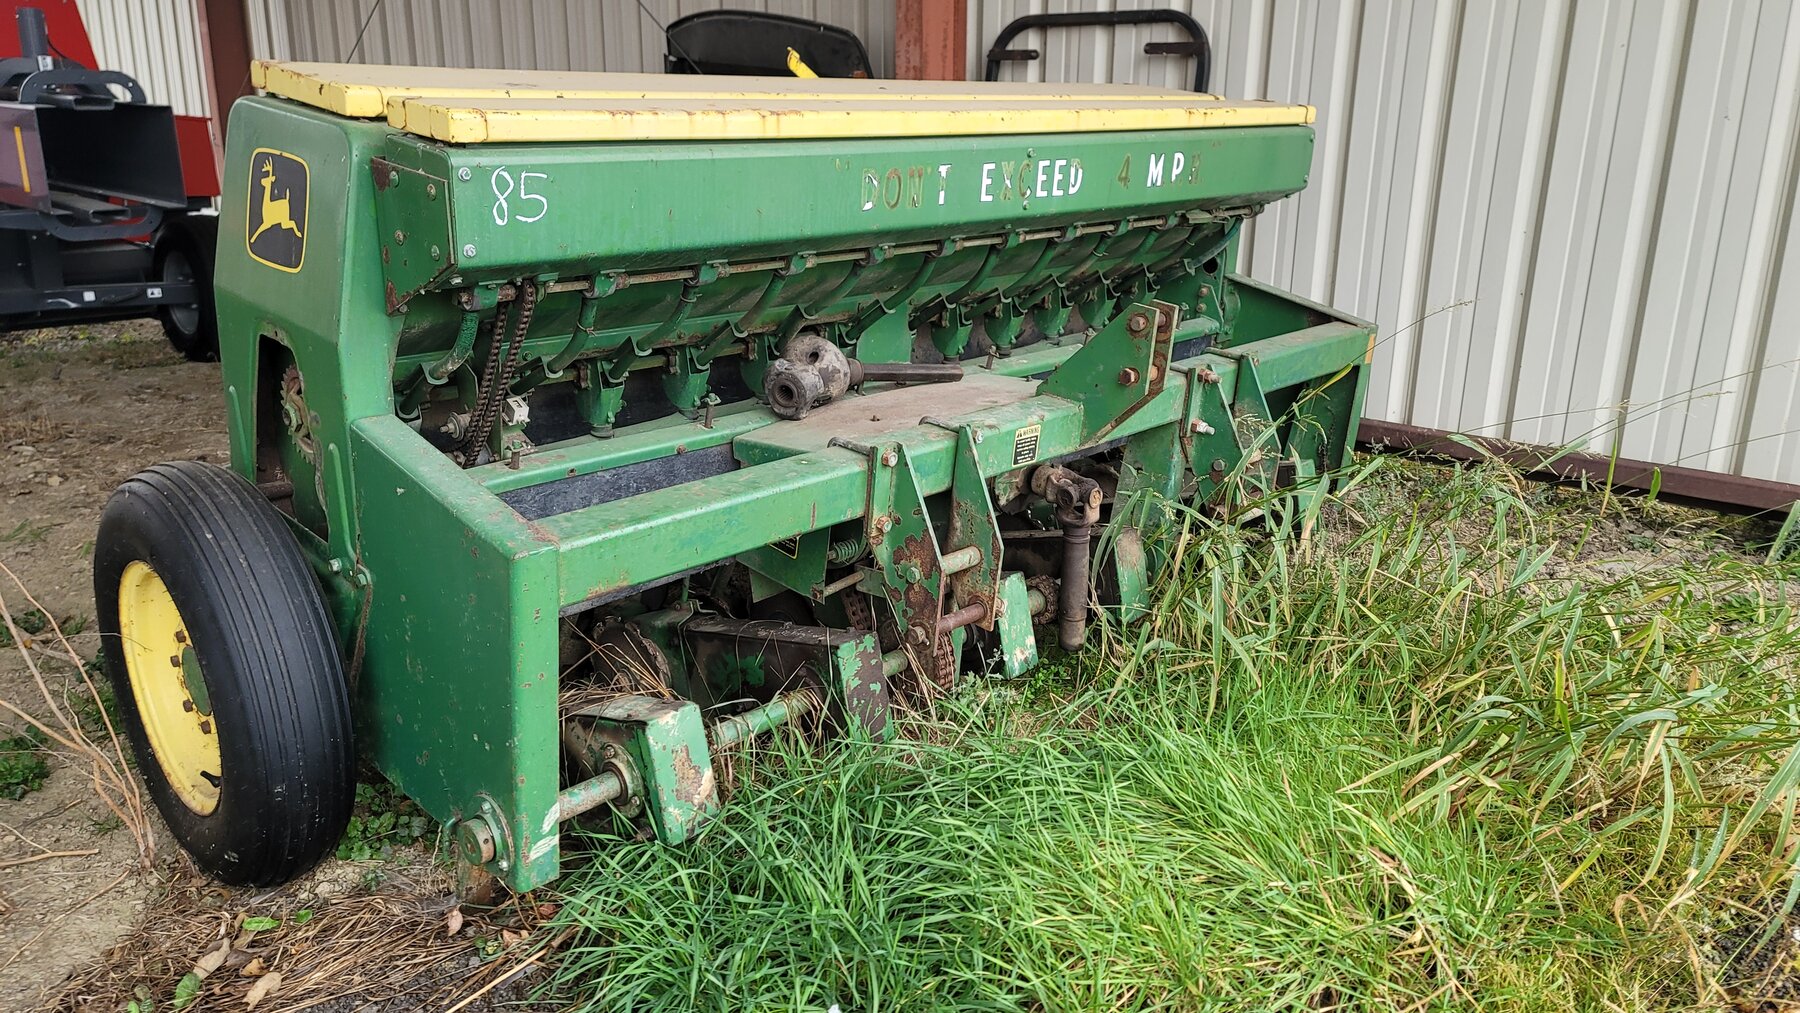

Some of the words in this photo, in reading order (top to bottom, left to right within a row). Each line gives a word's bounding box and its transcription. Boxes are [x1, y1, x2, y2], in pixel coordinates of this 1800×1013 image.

[491, 165, 548, 226] 85
[979, 157, 1083, 203] EXCEED
[1117, 152, 1132, 190] 4
